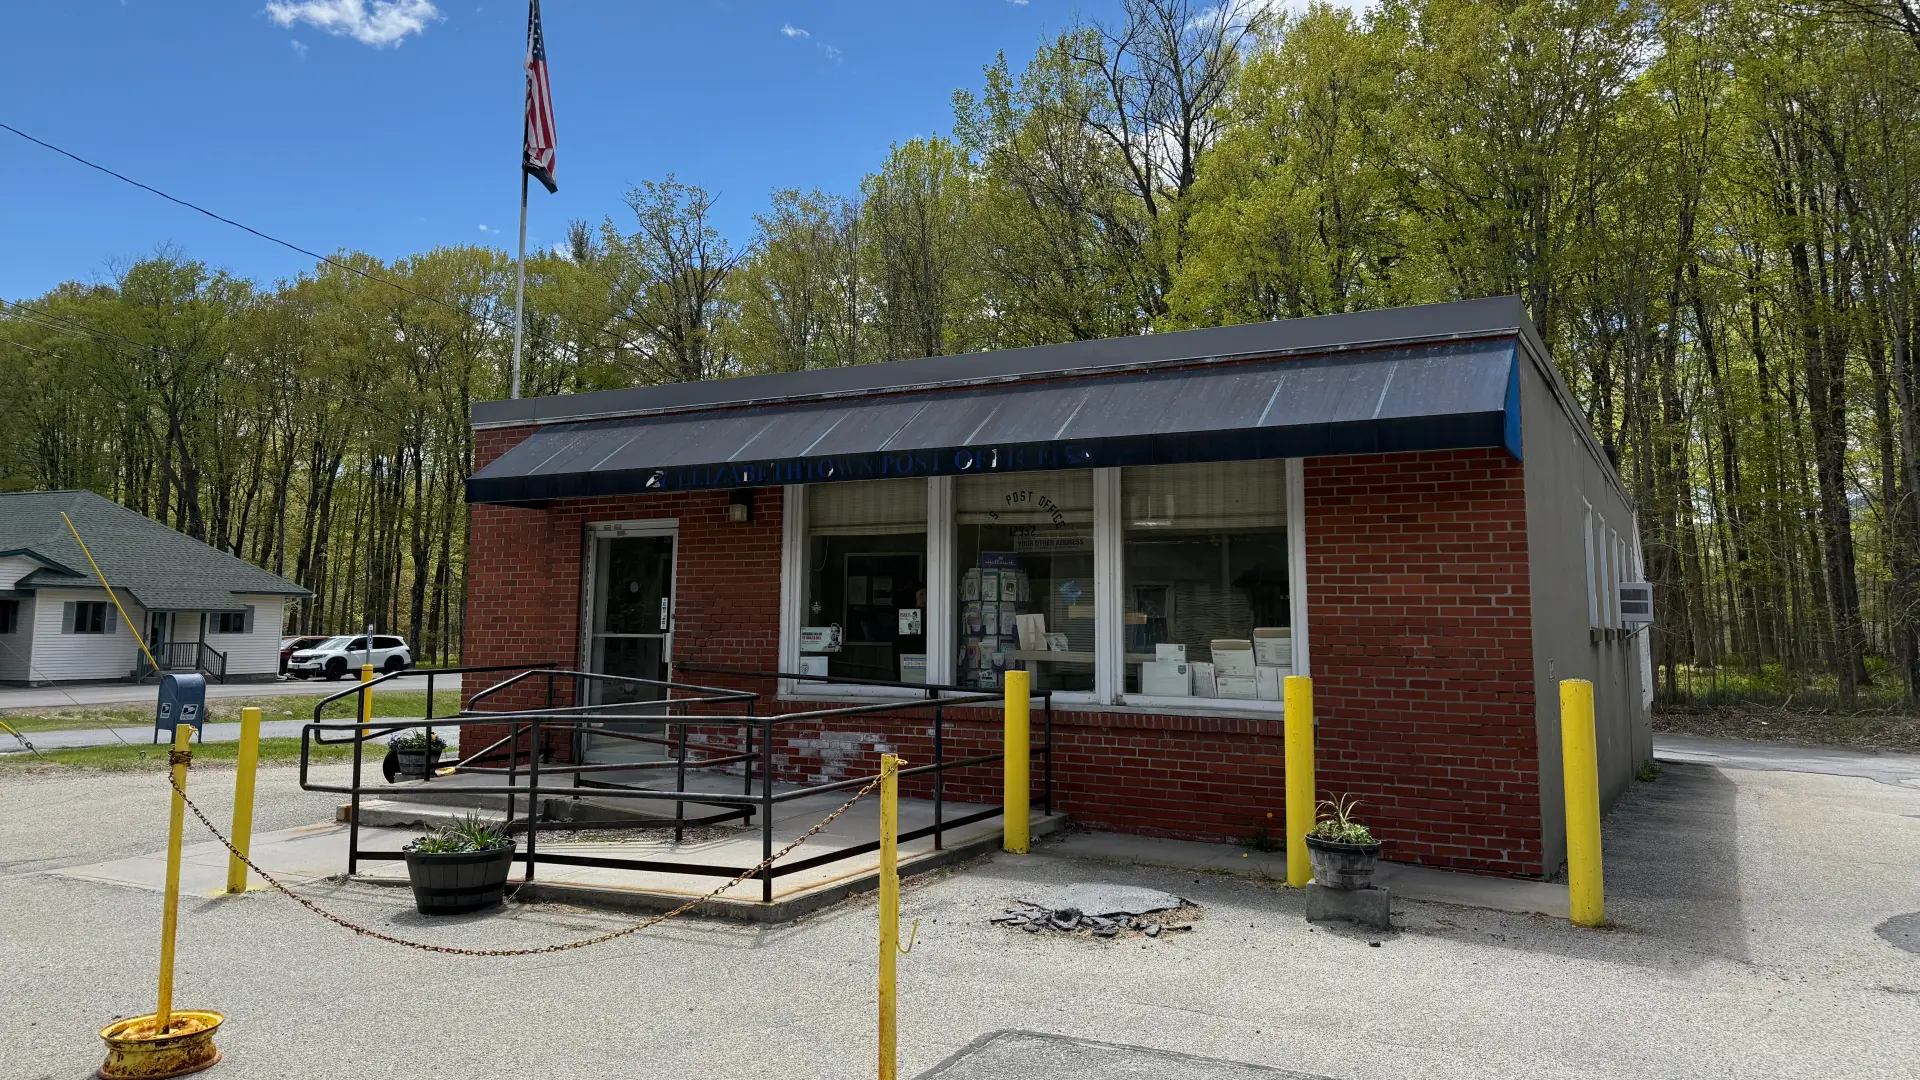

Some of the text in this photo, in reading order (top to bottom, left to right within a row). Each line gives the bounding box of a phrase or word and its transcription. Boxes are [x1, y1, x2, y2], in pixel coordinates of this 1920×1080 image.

[1005, 490, 1033, 506] POST
[1038, 495, 1066, 530] OFFICE
[1034, 539, 1055, 547] OTHER
[1055, 538, 1084, 546] ADDRESS
[984, 558, 1017, 568] Hallmark
